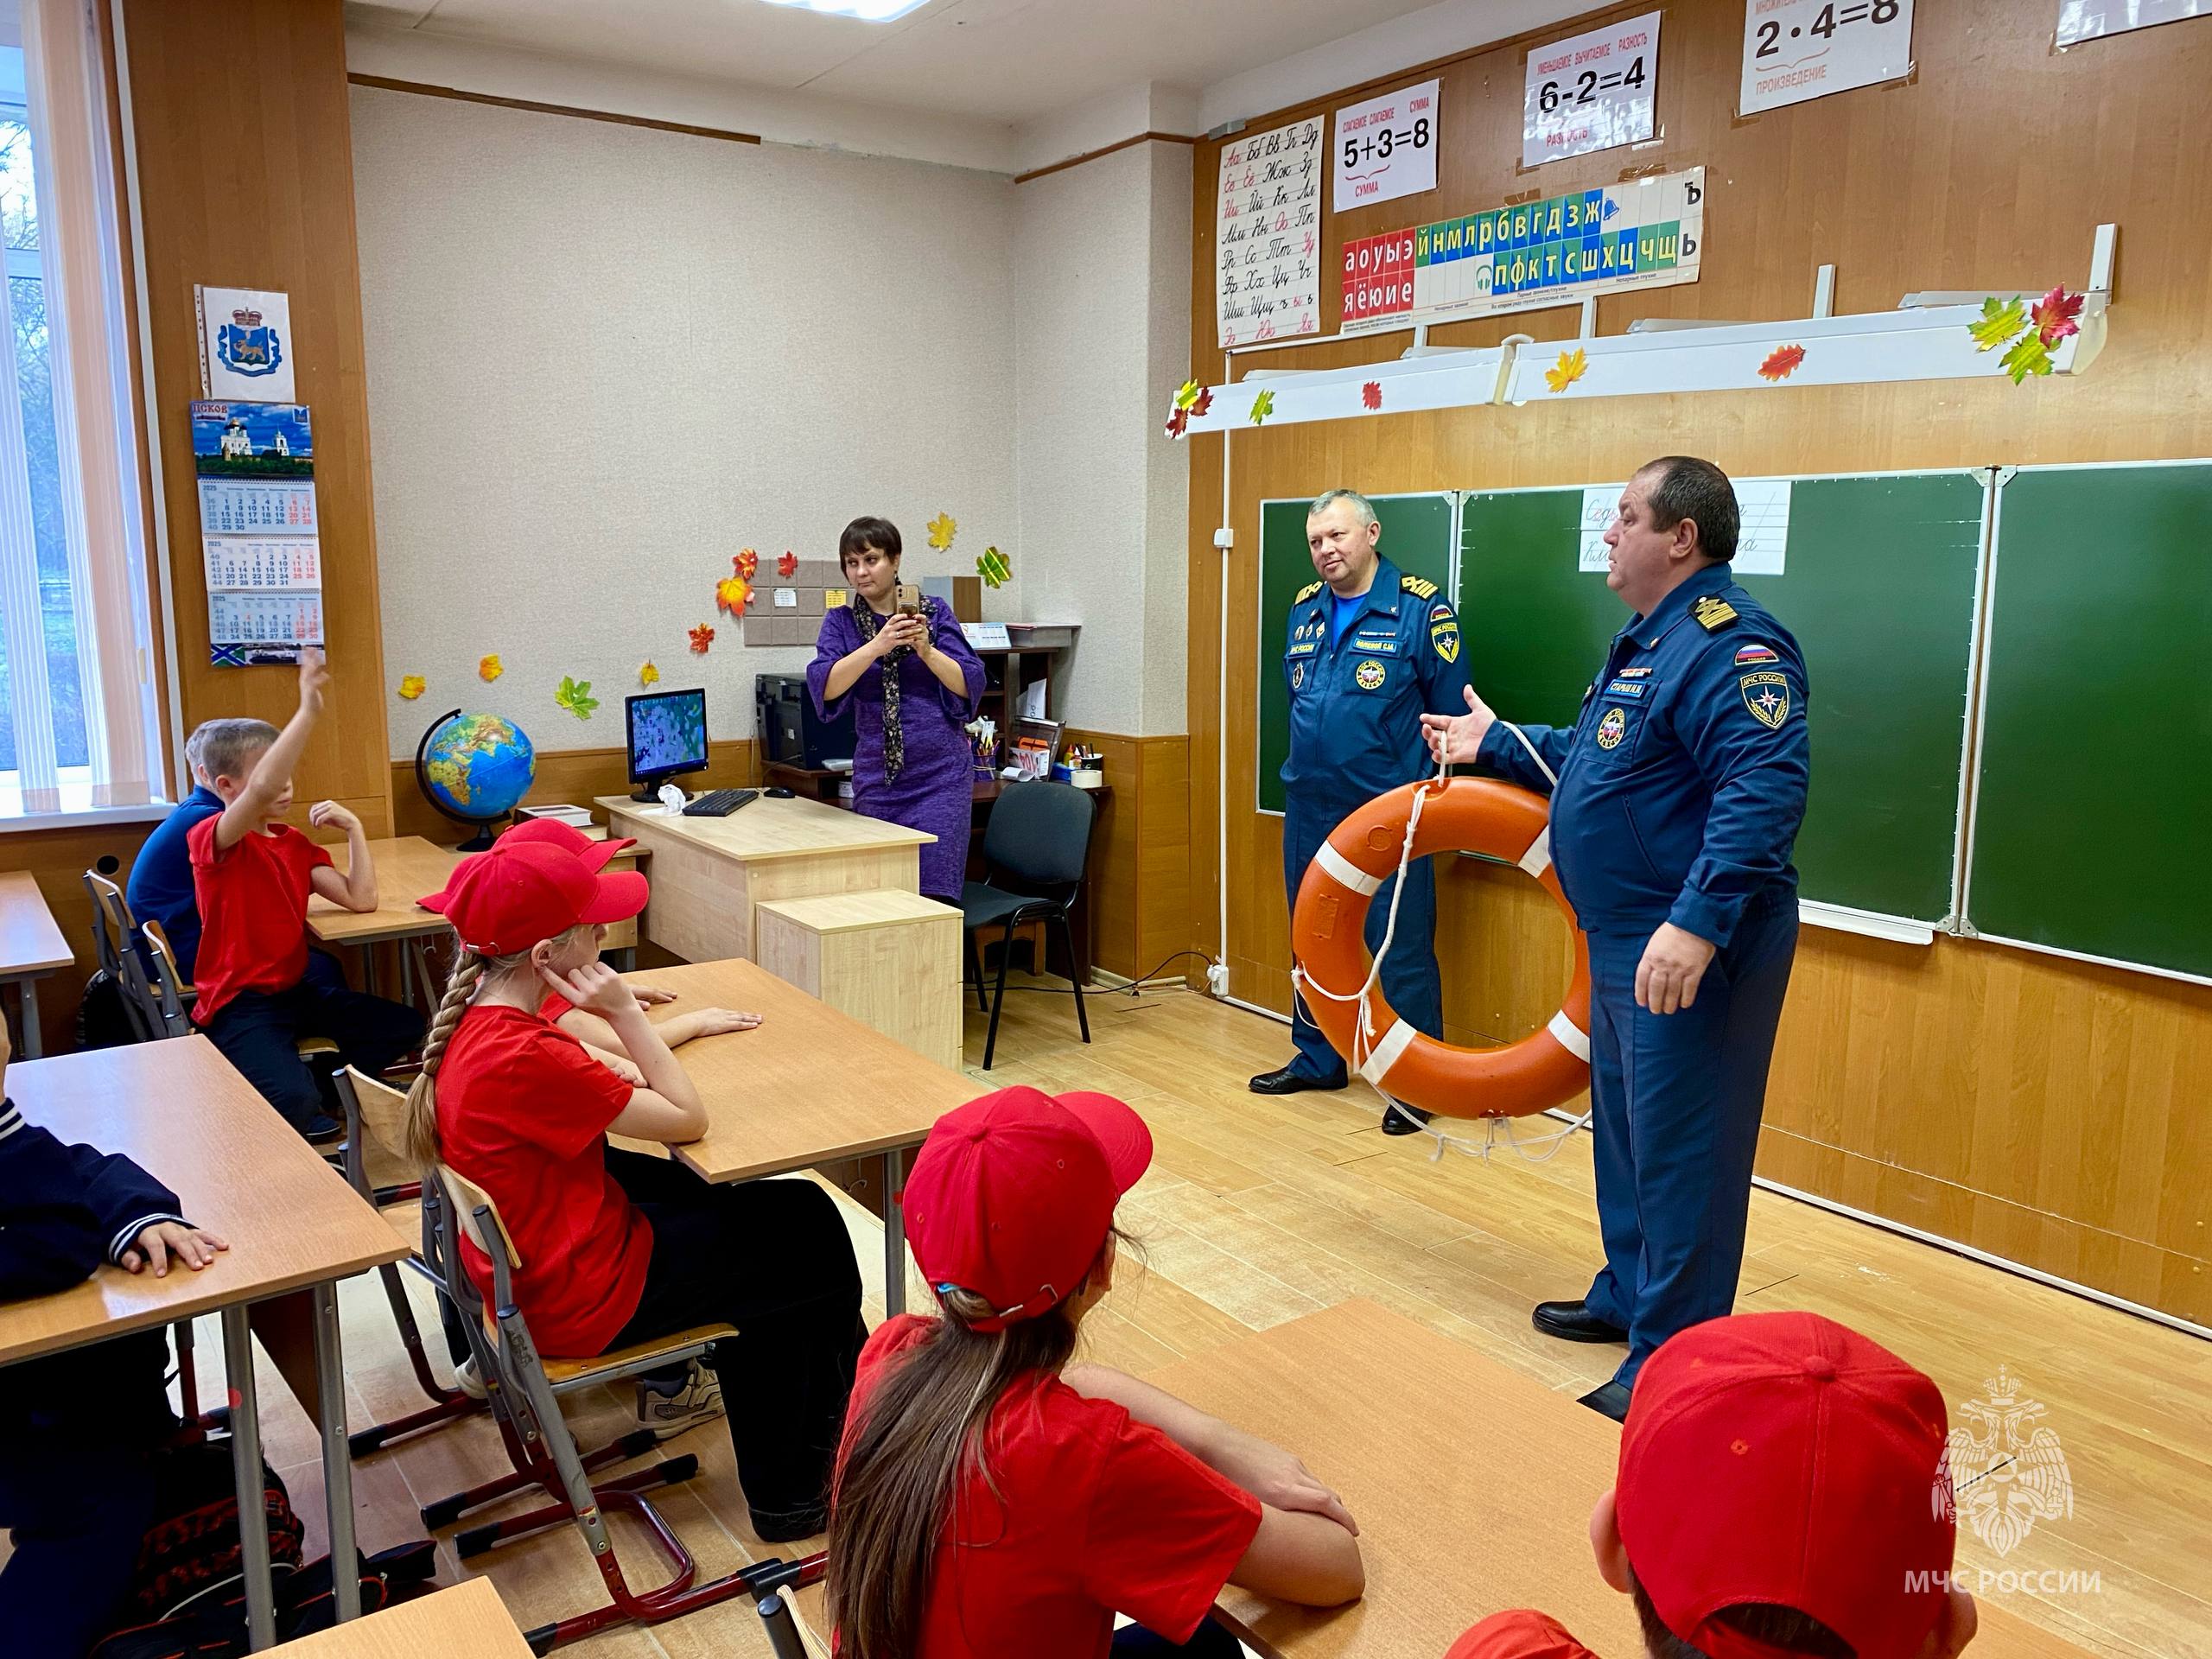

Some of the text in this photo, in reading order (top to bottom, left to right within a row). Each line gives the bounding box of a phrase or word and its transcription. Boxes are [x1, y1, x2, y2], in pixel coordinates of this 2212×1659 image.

[1574, 43, 1611, 65] ВЫЧИТАЕМОЕ
[1618, 32, 1648, 52] РАЗНОСТЬ
[1539, 56, 1645, 113] 6-2=4
[1756, 64, 1827, 95] ПРОИЗВЕДЕНИЕ
[1409, 97, 1430, 113] СУММА
[1344, 118, 1429, 168] 5+3=8
[1355, 181, 1378, 197] СУММА
[1744, 675, 1784, 686] МЧС РОССИИ
